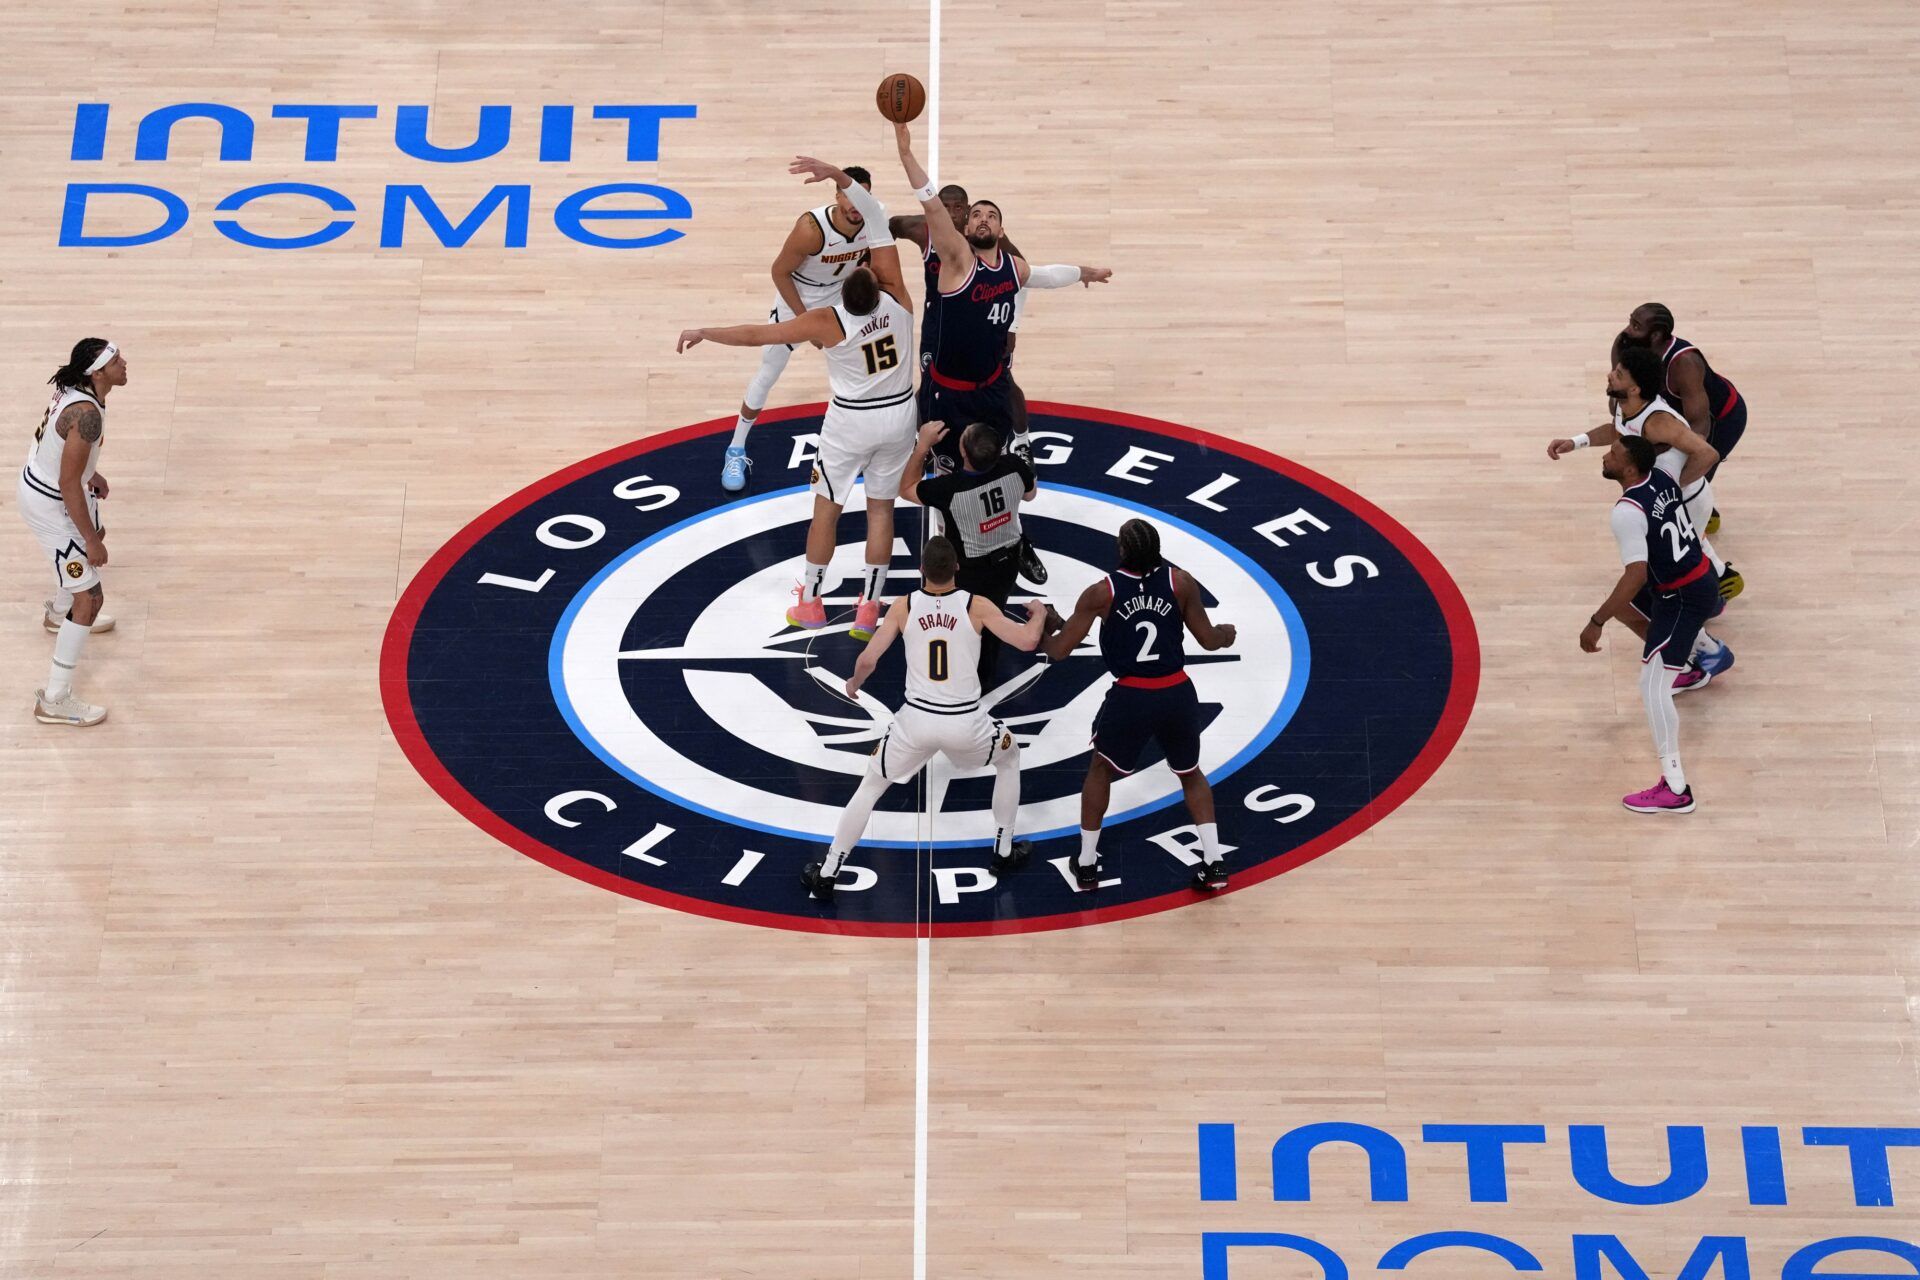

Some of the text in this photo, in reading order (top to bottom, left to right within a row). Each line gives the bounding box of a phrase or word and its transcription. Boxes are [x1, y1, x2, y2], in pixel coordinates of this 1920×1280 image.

[821, 248, 866, 264] NUGGET
[971, 280, 1015, 303] Clippers
[987, 302, 1011, 325] 40
[861, 333, 899, 375] 15
[477, 431, 1380, 593] LOS AGELES
[980, 486, 1006, 517] 16
[1651, 487, 1679, 520] POWELL
[983, 515, 1010, 531] Emirates
[1660, 504, 1696, 563] 24
[918, 613, 958, 631] BRAUN
[1116, 595, 1173, 620] LEONARD
[1135, 620, 1160, 663] 2
[929, 638, 948, 682] 0
